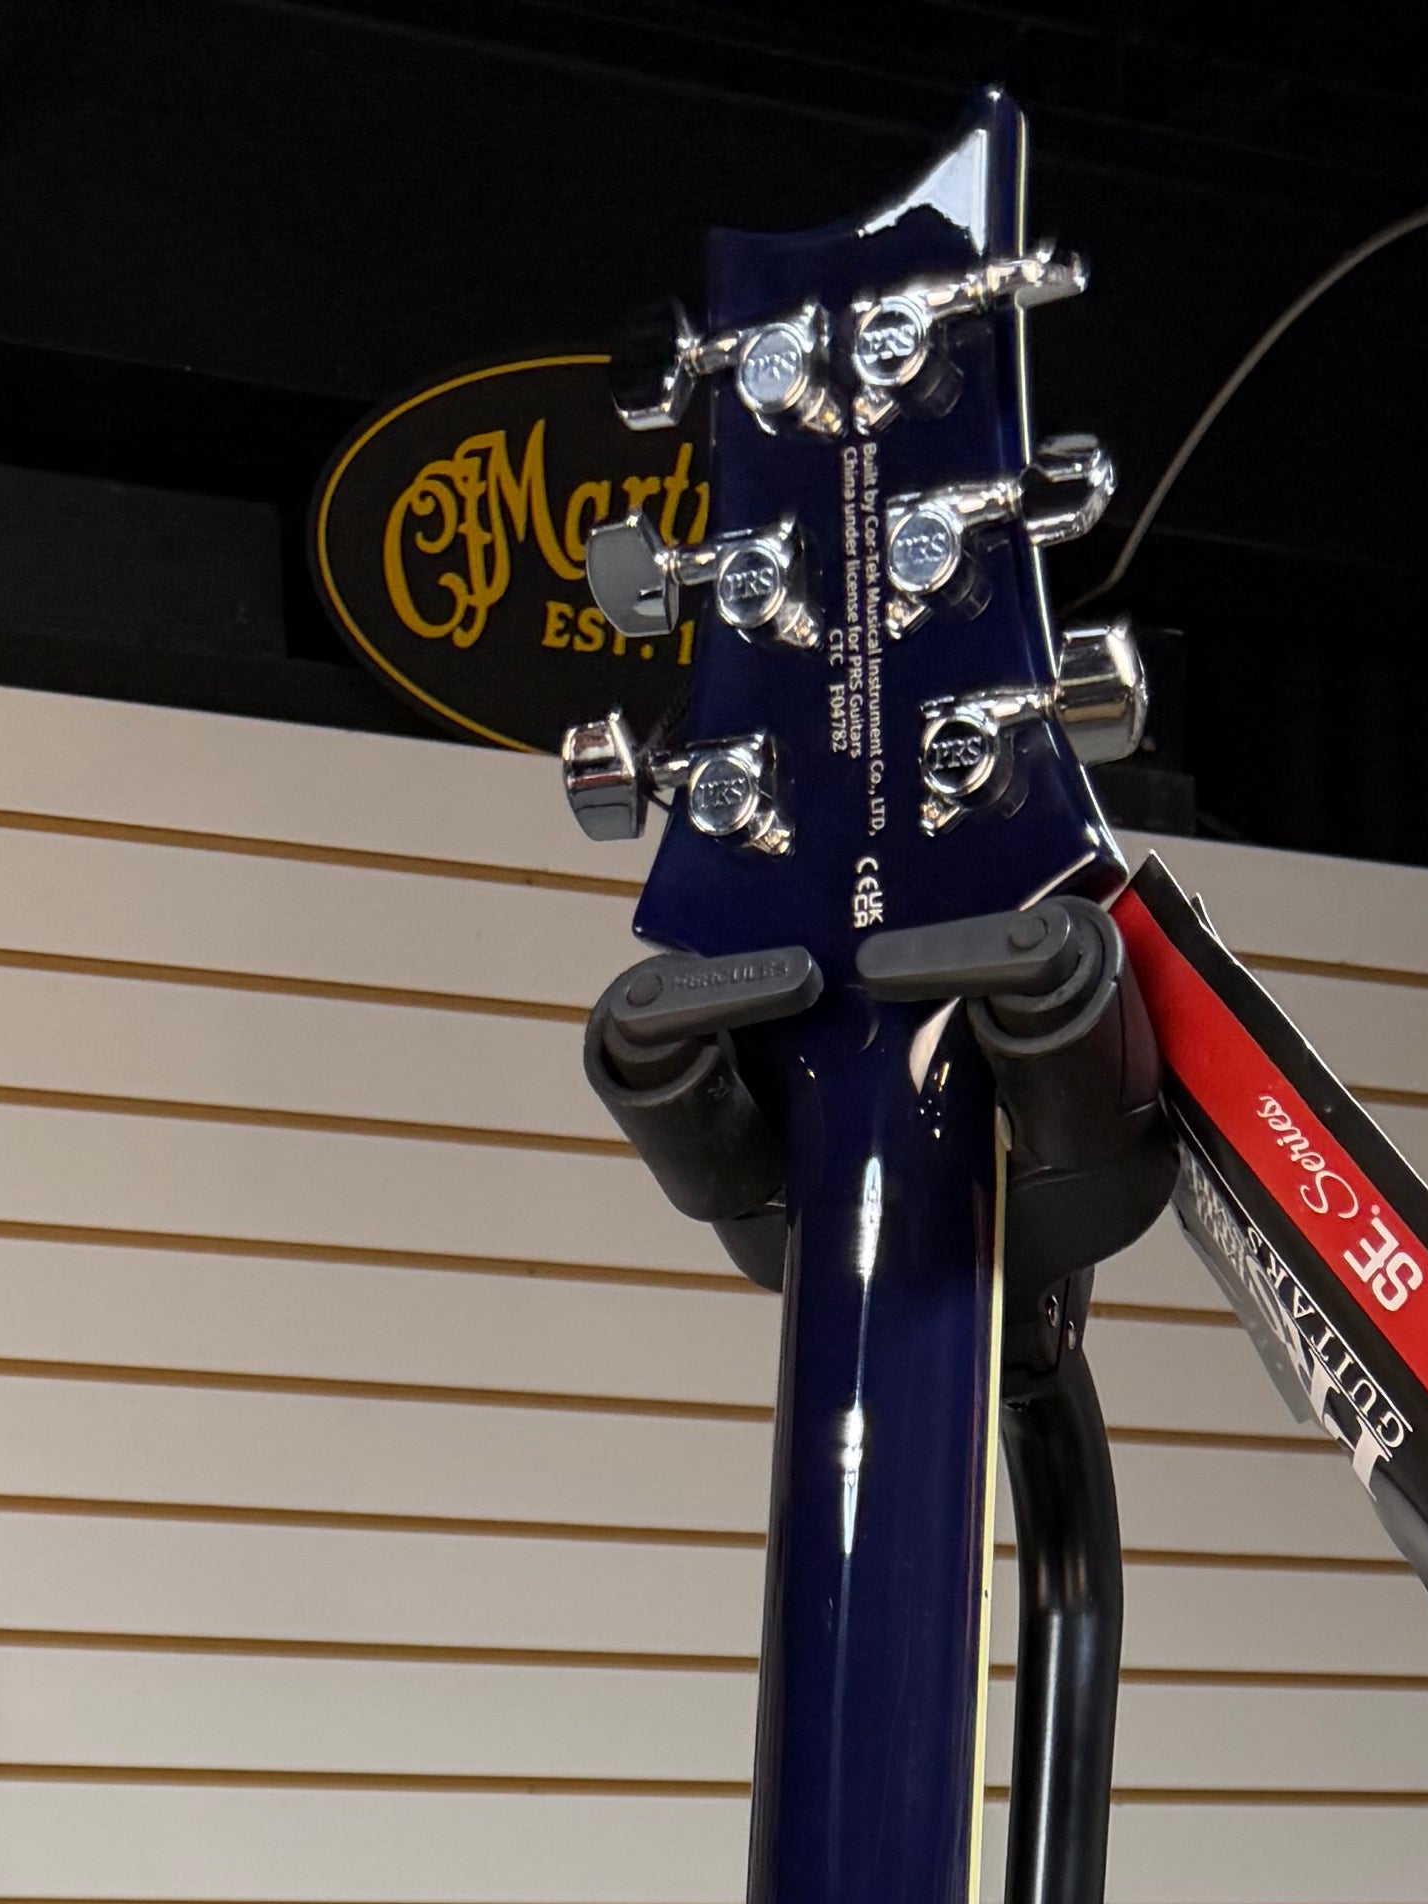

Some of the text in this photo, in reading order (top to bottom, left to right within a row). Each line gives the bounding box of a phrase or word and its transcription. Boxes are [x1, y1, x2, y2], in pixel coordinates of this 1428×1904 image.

[861, 488, 880, 512] by
[862, 442, 879, 487] Built
[725, 566, 775, 602] PRS
[864, 514, 881, 585] Cor-Tek
[843, 446, 865, 760] China under license for PRS Guitars
[867, 586, 883, 655] Musical
[829, 628, 848, 753] CTC F04782
[868, 657, 884, 757] Instrument
[1256, 1095, 1359, 1219] Series
